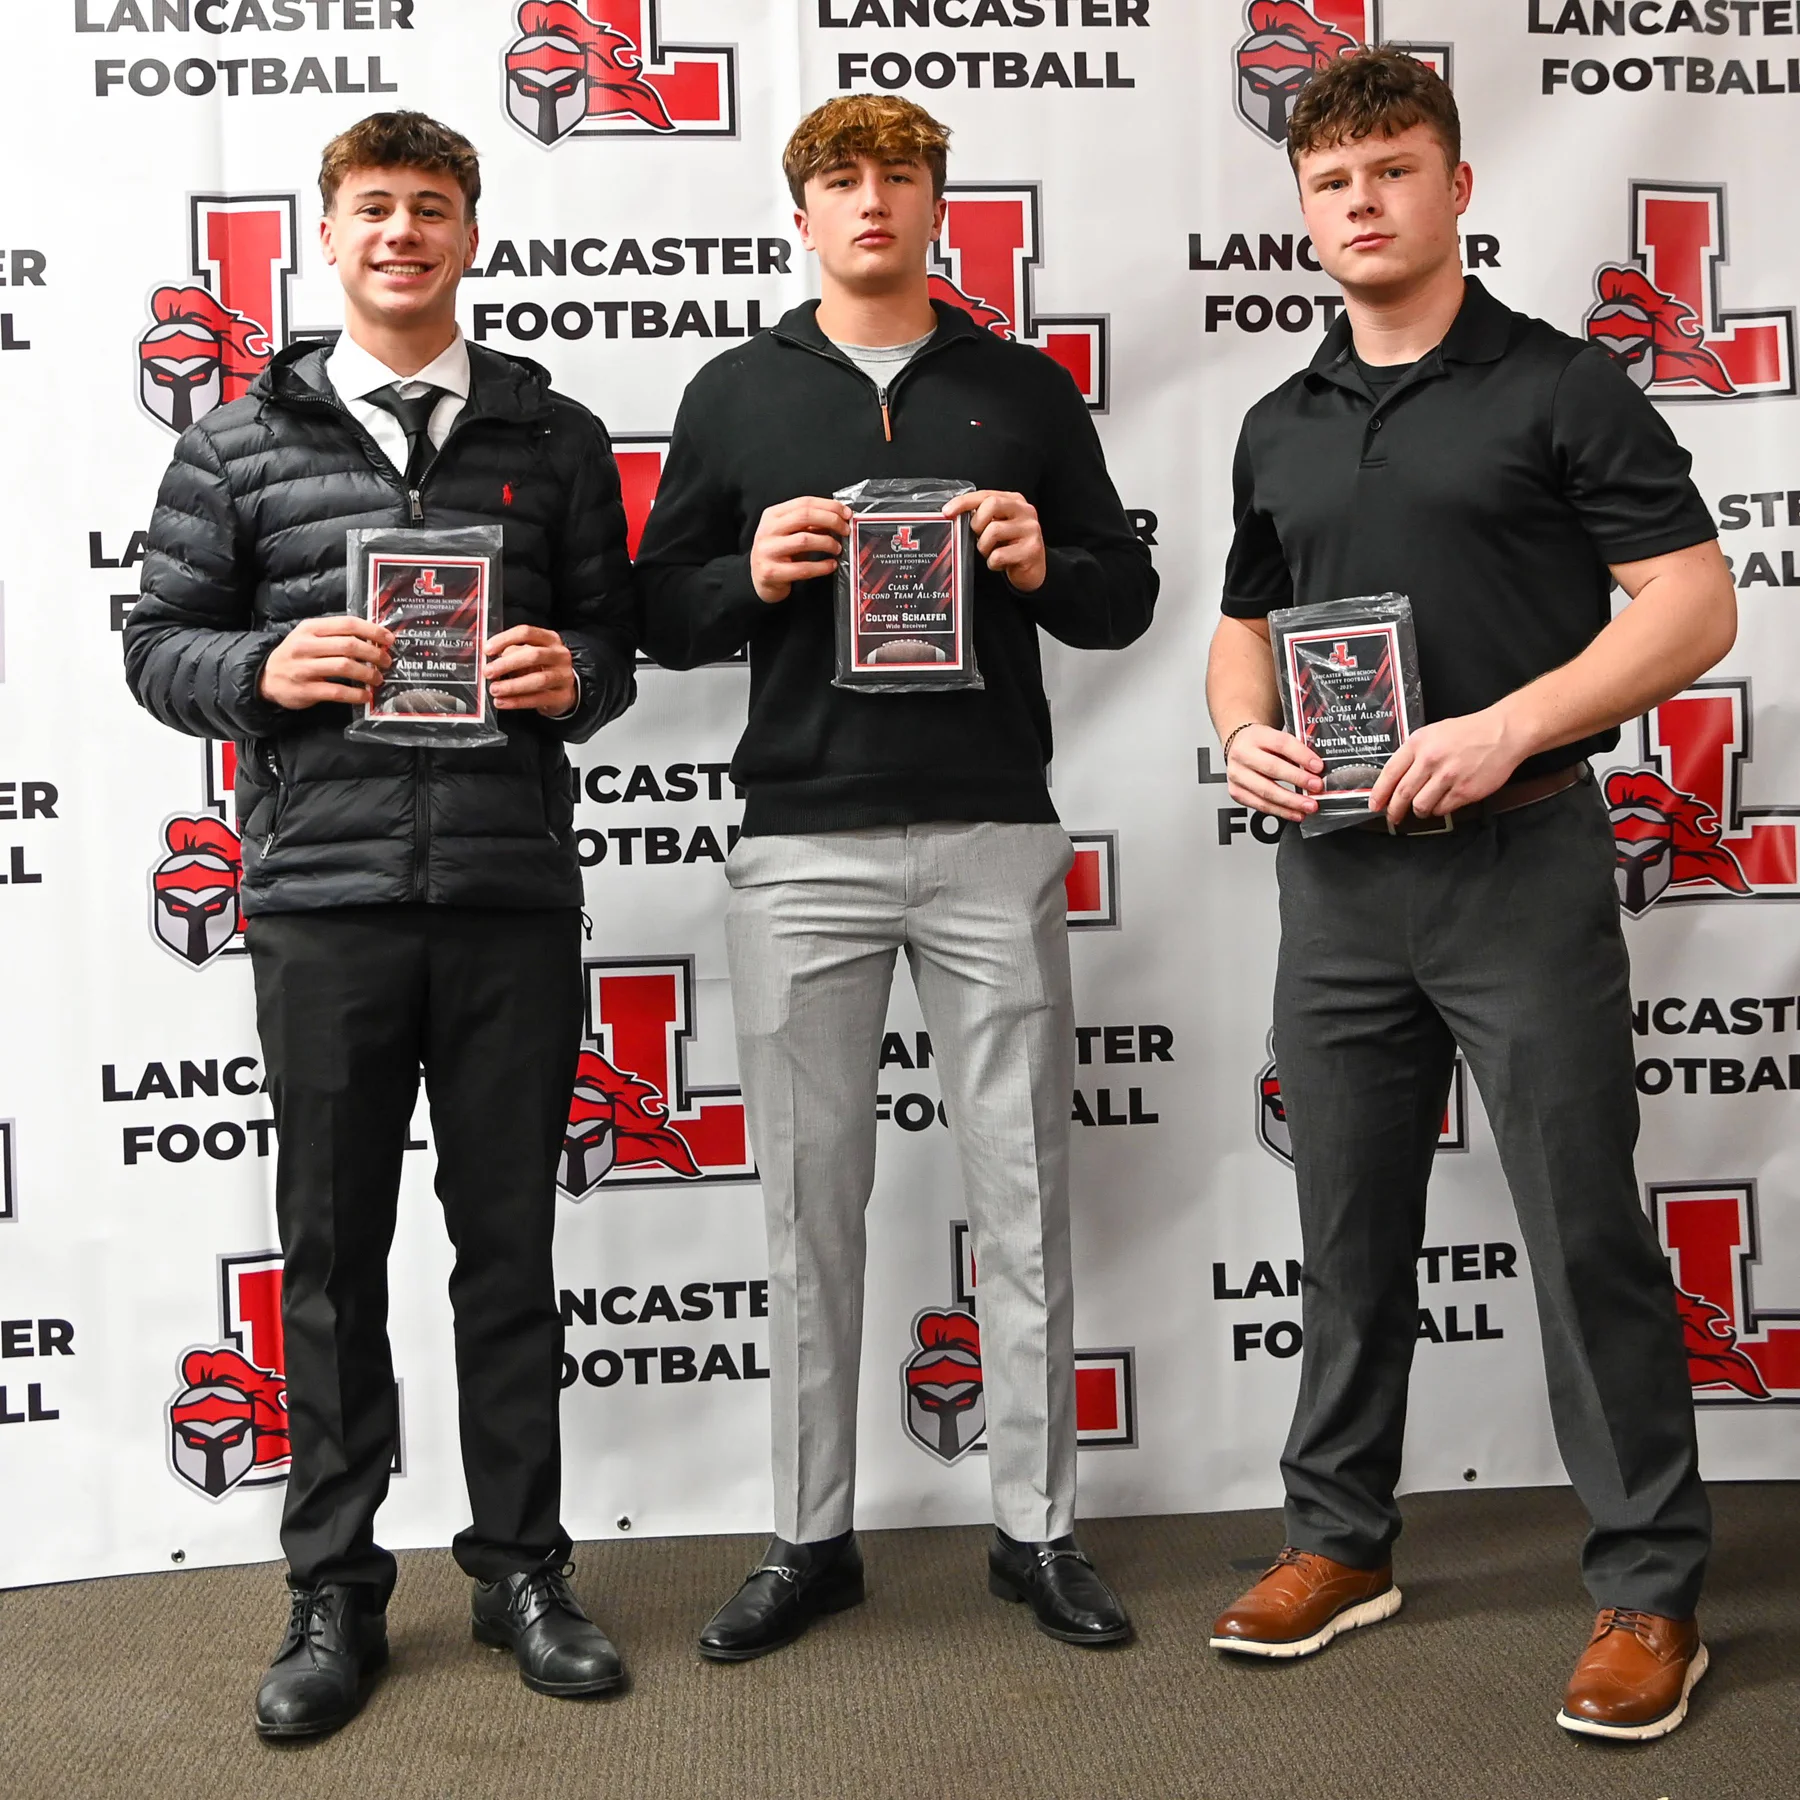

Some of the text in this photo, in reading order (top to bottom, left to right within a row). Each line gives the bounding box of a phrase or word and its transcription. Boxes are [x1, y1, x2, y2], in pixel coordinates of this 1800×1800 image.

[75, 0, 415, 34] LANCASTER
[818, 0, 1151, 28] LANCASTER
[1528, 0, 1800, 36] LANCASTE
[95, 56, 398, 97] FOOTBALL
[838, 51, 1136, 89] FOOTBALL
[1205, 295, 1346, 333] FOOT
[888, 583, 909, 591] CLASS
[863, 590, 950, 600] SECOND TEAM ALL-STAR
[865, 612, 947, 622] COLTON SCHAEFER
[434, 630, 447, 638] AA
[414, 639, 435, 647] TEAM
[438, 639, 474, 648] ALL-STAR
[396, 660, 457, 671] AIDEN BANKS
[1331, 702, 1367, 713] CLASS AA
[1307, 710, 1394, 724] SECOND TEAM ALL-STAR
[1314, 733, 1391, 748] JUSTIN TEUBNER
